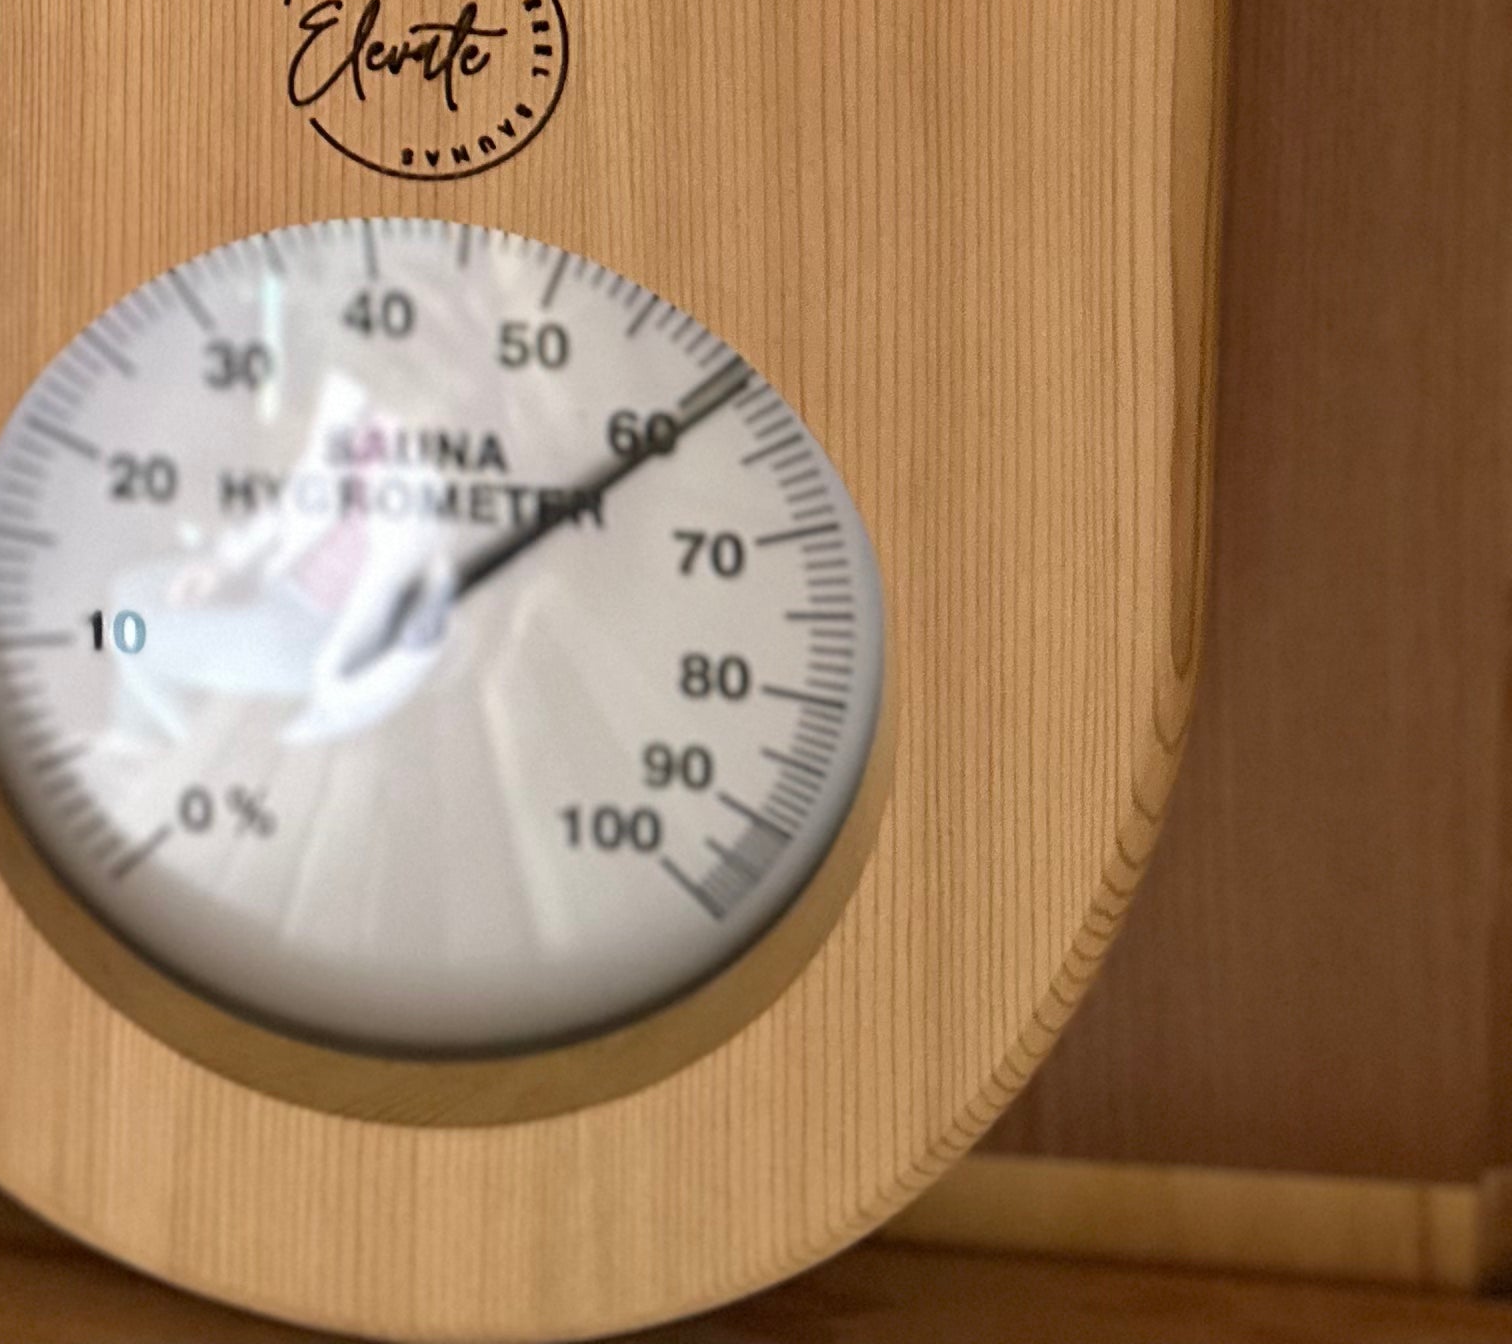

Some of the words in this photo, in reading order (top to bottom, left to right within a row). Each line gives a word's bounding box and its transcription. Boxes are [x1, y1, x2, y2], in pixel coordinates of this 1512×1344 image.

[401, 103, 533, 167] SAUNAS
[342, 293, 414, 339] 40
[203, 343, 272, 392] 30
[498, 320, 570, 371] 50
[325, 430, 508, 474] SAUNA
[608, 410, 678, 457] 60
[108, 455, 178, 502] 20
[674, 530, 745, 576] 70
[90, 609, 147, 654] 10
[678, 654, 750, 701] 80
[643, 742, 713, 791] 90
[180, 786, 214, 834] 0
[561, 806, 662, 852] 100
